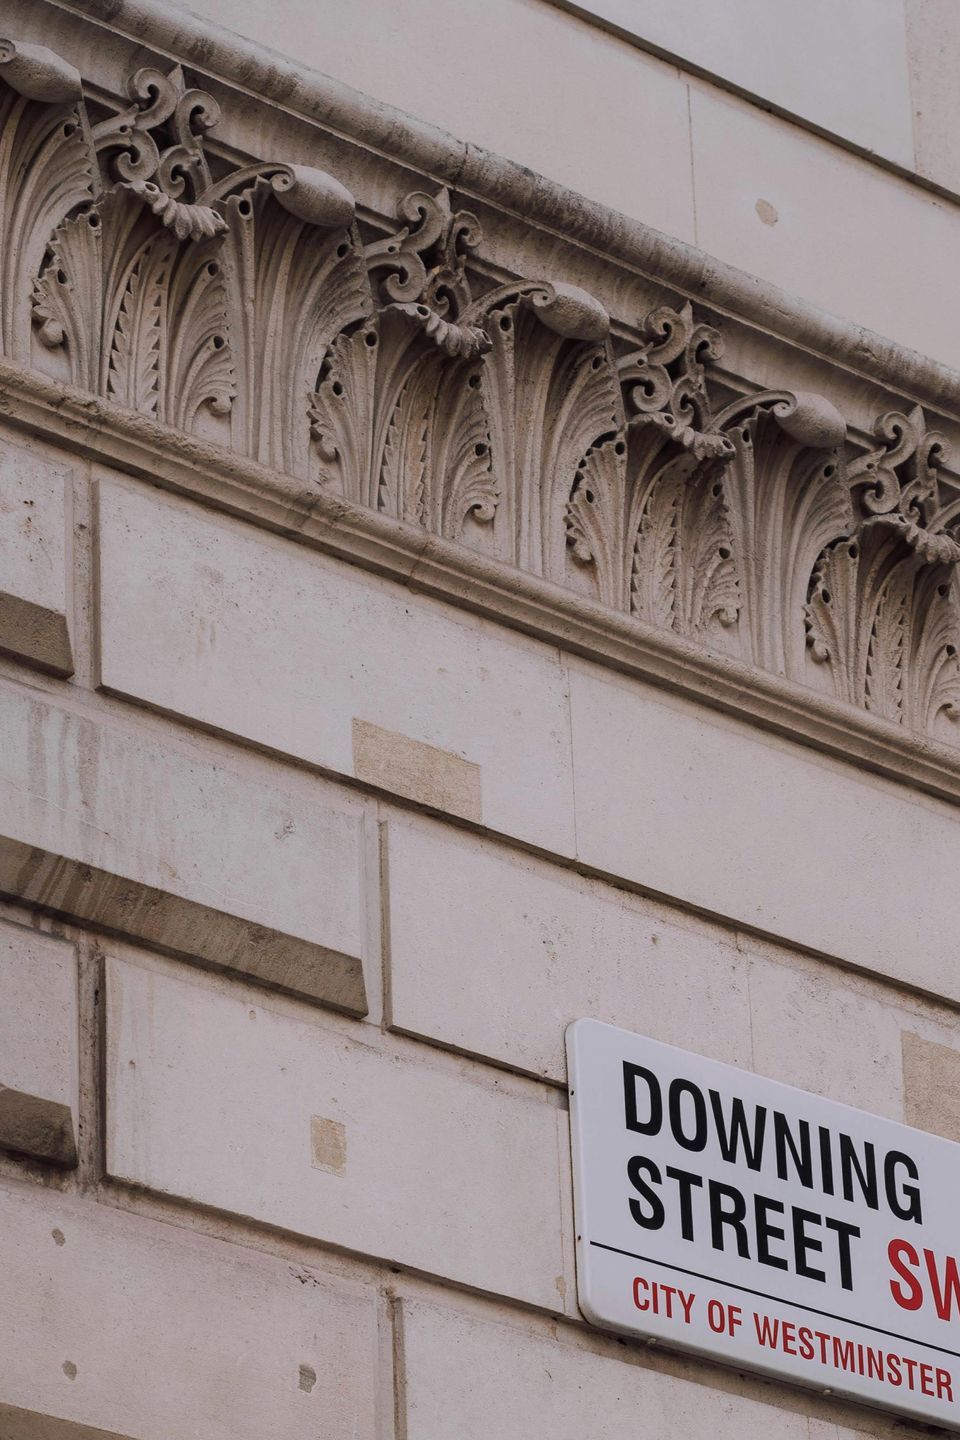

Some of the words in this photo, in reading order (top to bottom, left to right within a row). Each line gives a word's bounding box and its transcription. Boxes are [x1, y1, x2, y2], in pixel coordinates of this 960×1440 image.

[622, 1060, 923, 1225] DOWNING
[627, 1155, 861, 1292] STREET
[632, 1276, 698, 1324] CITY
[707, 1298, 742, 1338] OF
[753, 1313, 954, 1402] WESTMINSTER
